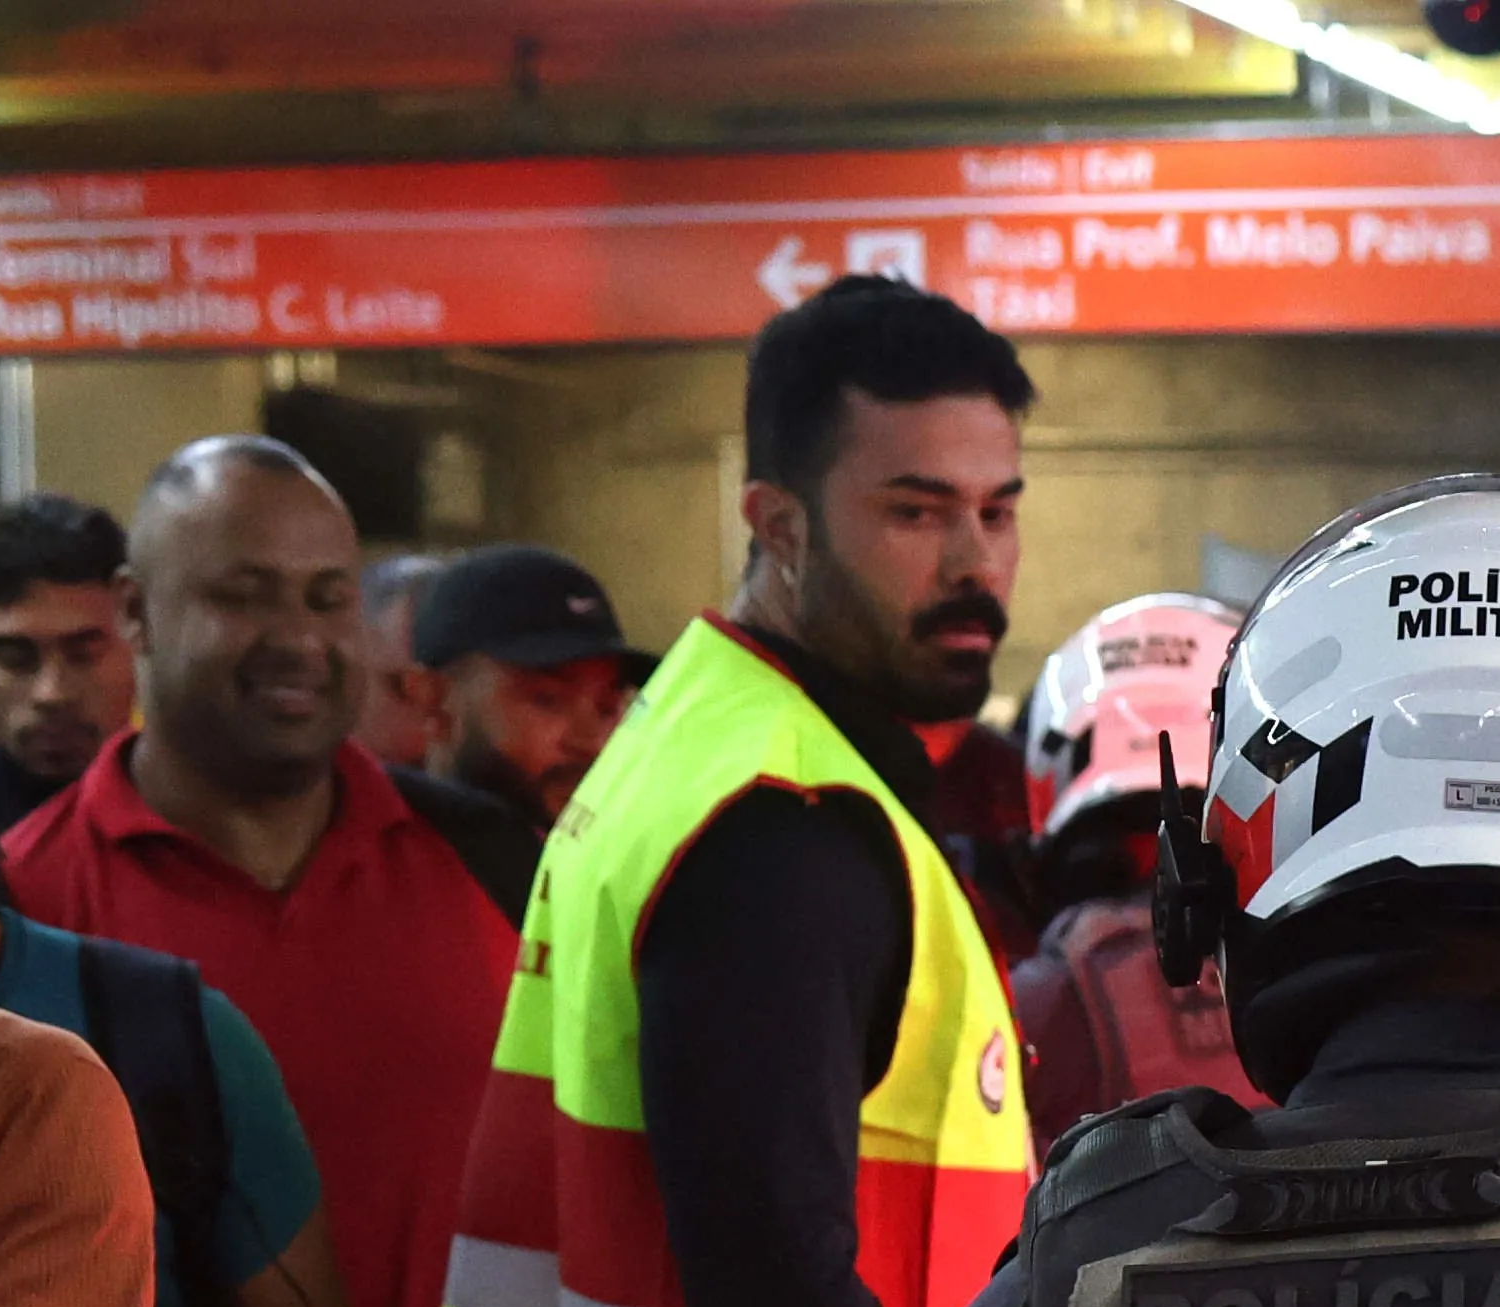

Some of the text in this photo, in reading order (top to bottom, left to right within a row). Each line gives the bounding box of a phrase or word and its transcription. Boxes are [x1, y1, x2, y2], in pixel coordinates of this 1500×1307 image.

[964, 211, 1491, 270] Rua Prof. Melo Paiva
[326, 286, 445, 333] Leite
